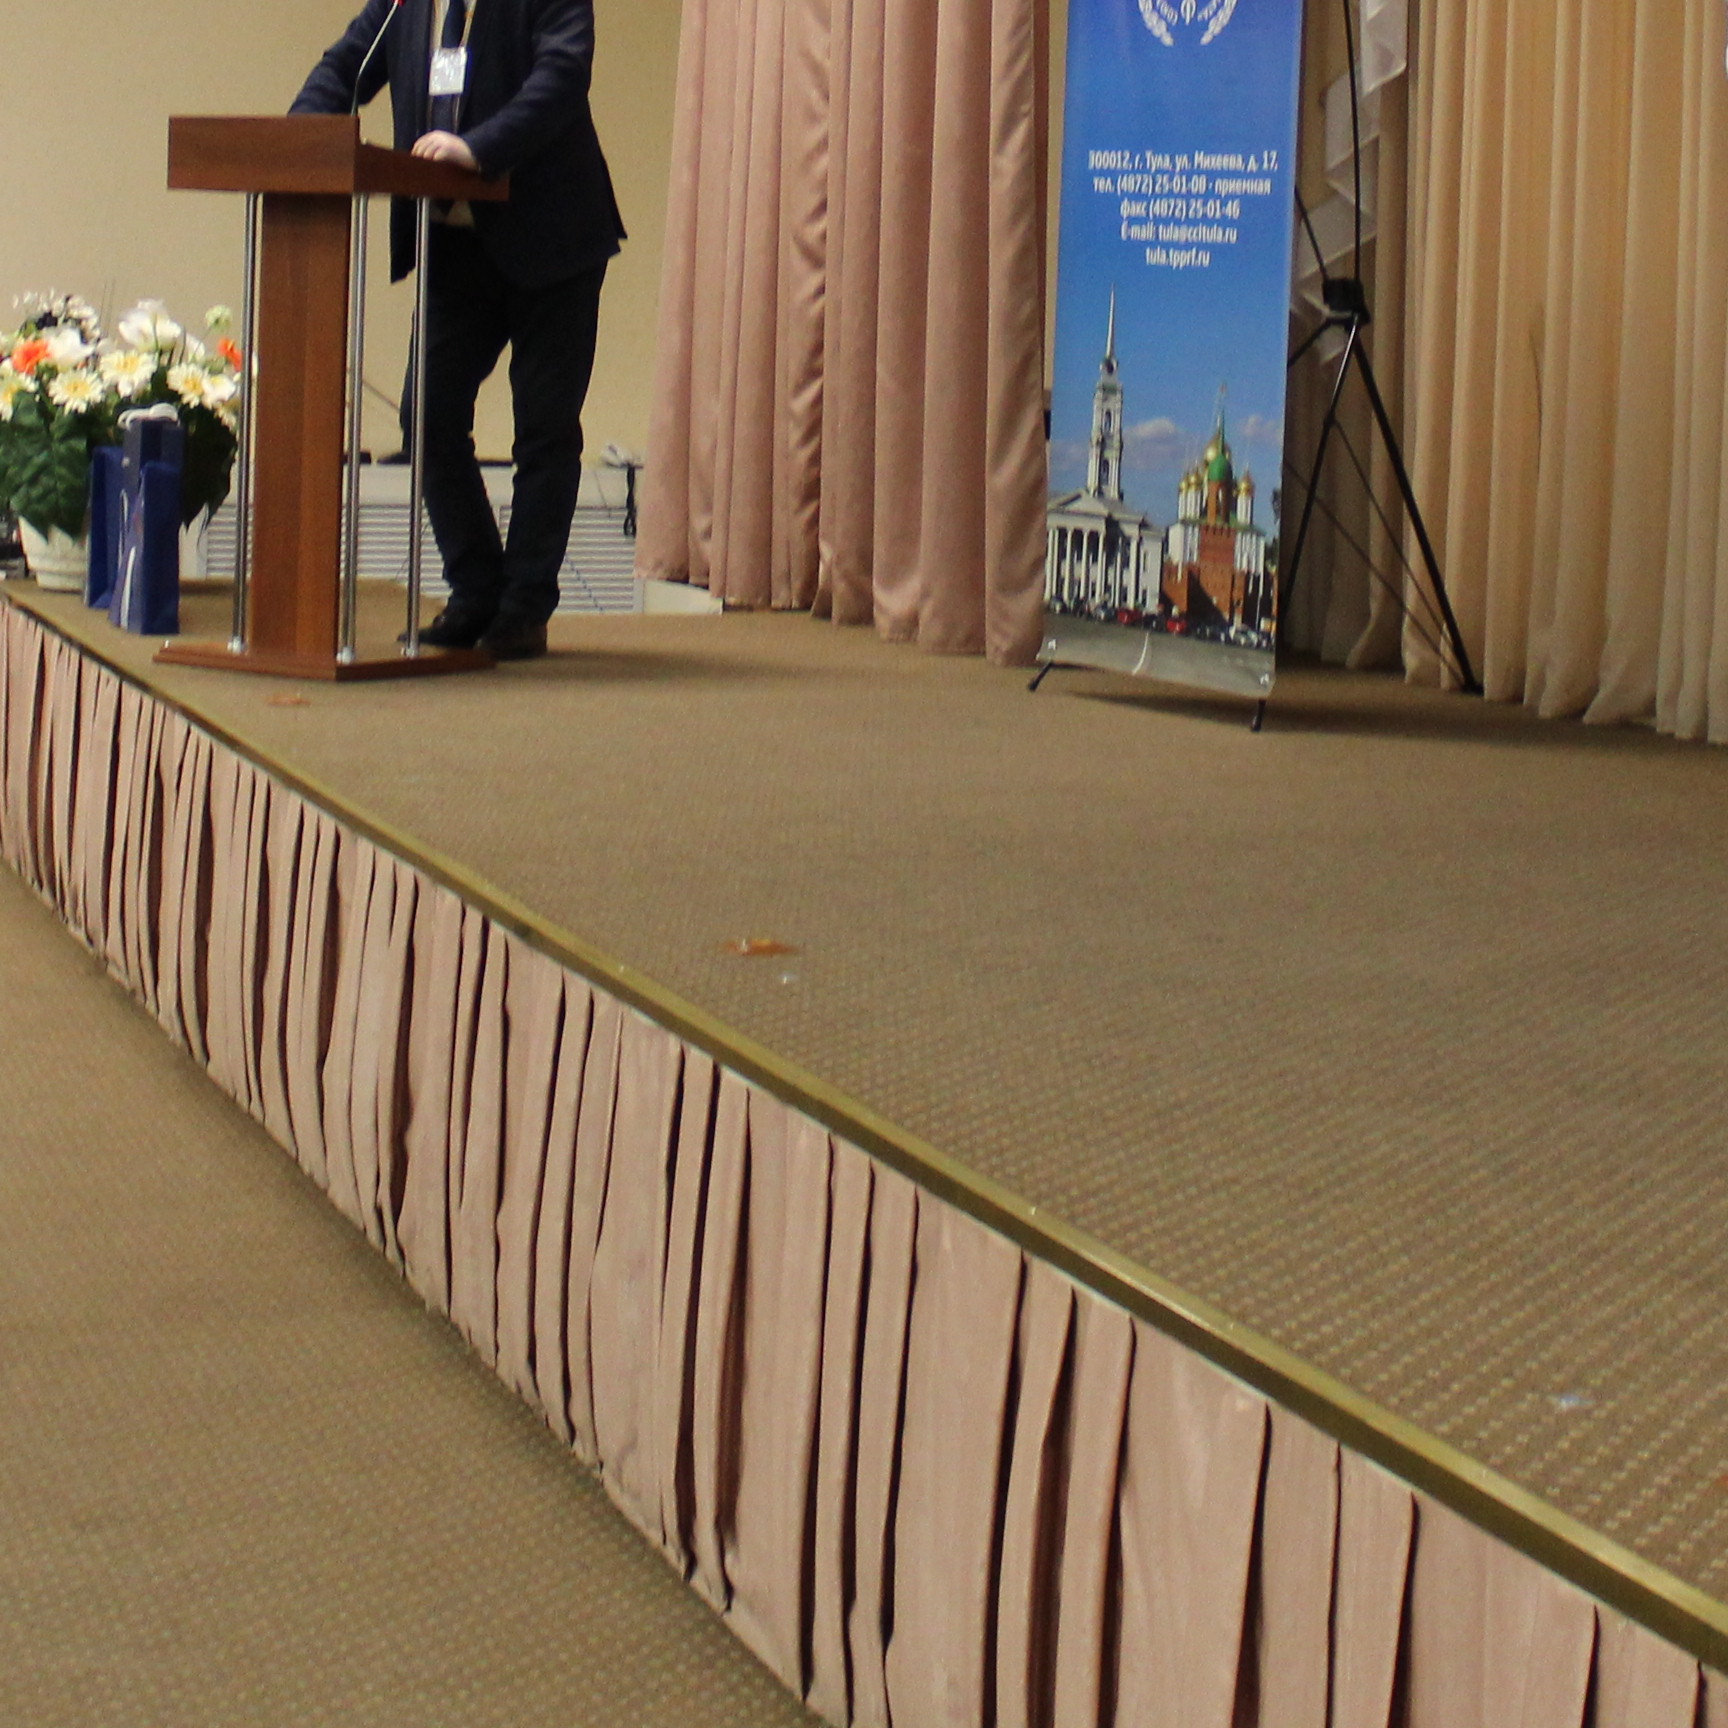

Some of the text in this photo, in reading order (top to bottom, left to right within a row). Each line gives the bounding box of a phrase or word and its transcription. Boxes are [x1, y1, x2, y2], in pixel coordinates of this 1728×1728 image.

[1145, 149, 1173, 174] Тула,
[1193, 149, 1246, 172] Михеева,
[1093, 176, 1115, 194] тел.
[1214, 177, 1272, 198] приемная
[1120, 197, 1147, 220] факс
[1188, 198, 1241, 220] 25-01-46
